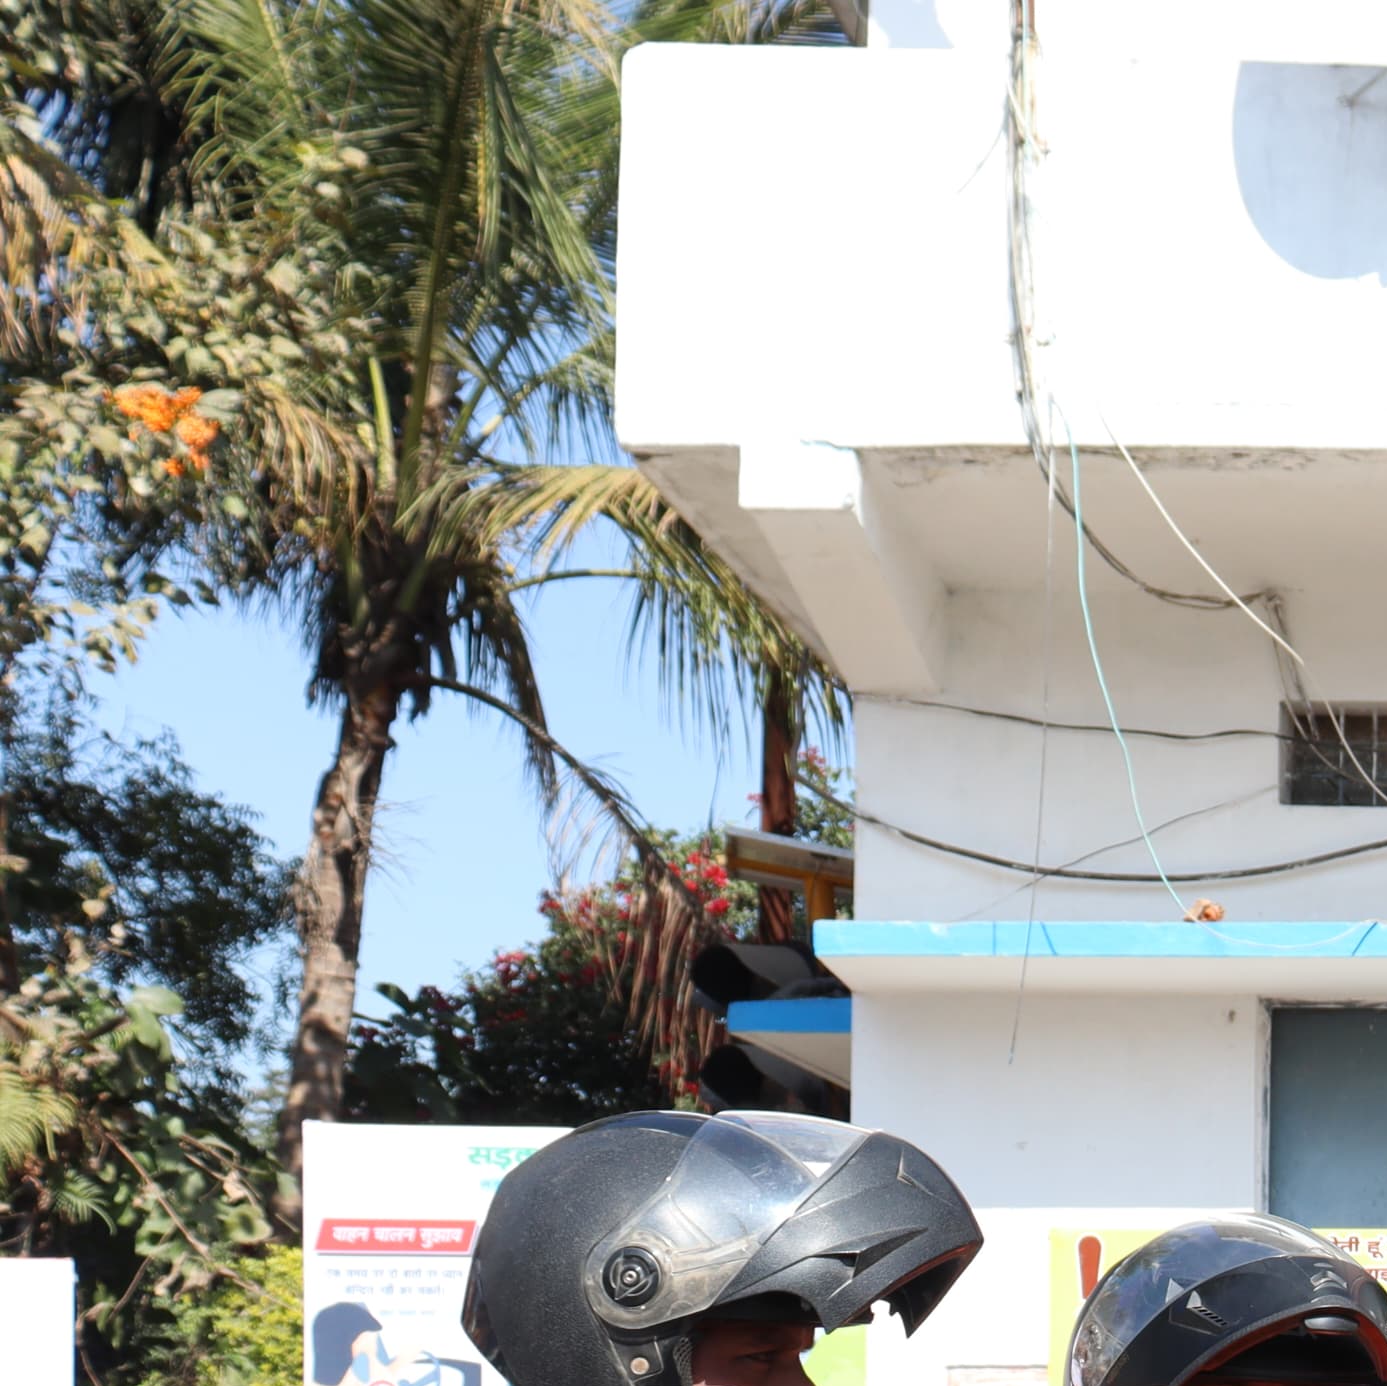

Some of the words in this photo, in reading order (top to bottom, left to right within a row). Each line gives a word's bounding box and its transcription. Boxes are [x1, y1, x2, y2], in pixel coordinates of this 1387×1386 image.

[332, 1226, 369, 1244] वाहन
[373, 1227, 416, 1243] चालन
[419, 1227, 463, 1248] सुझाव
